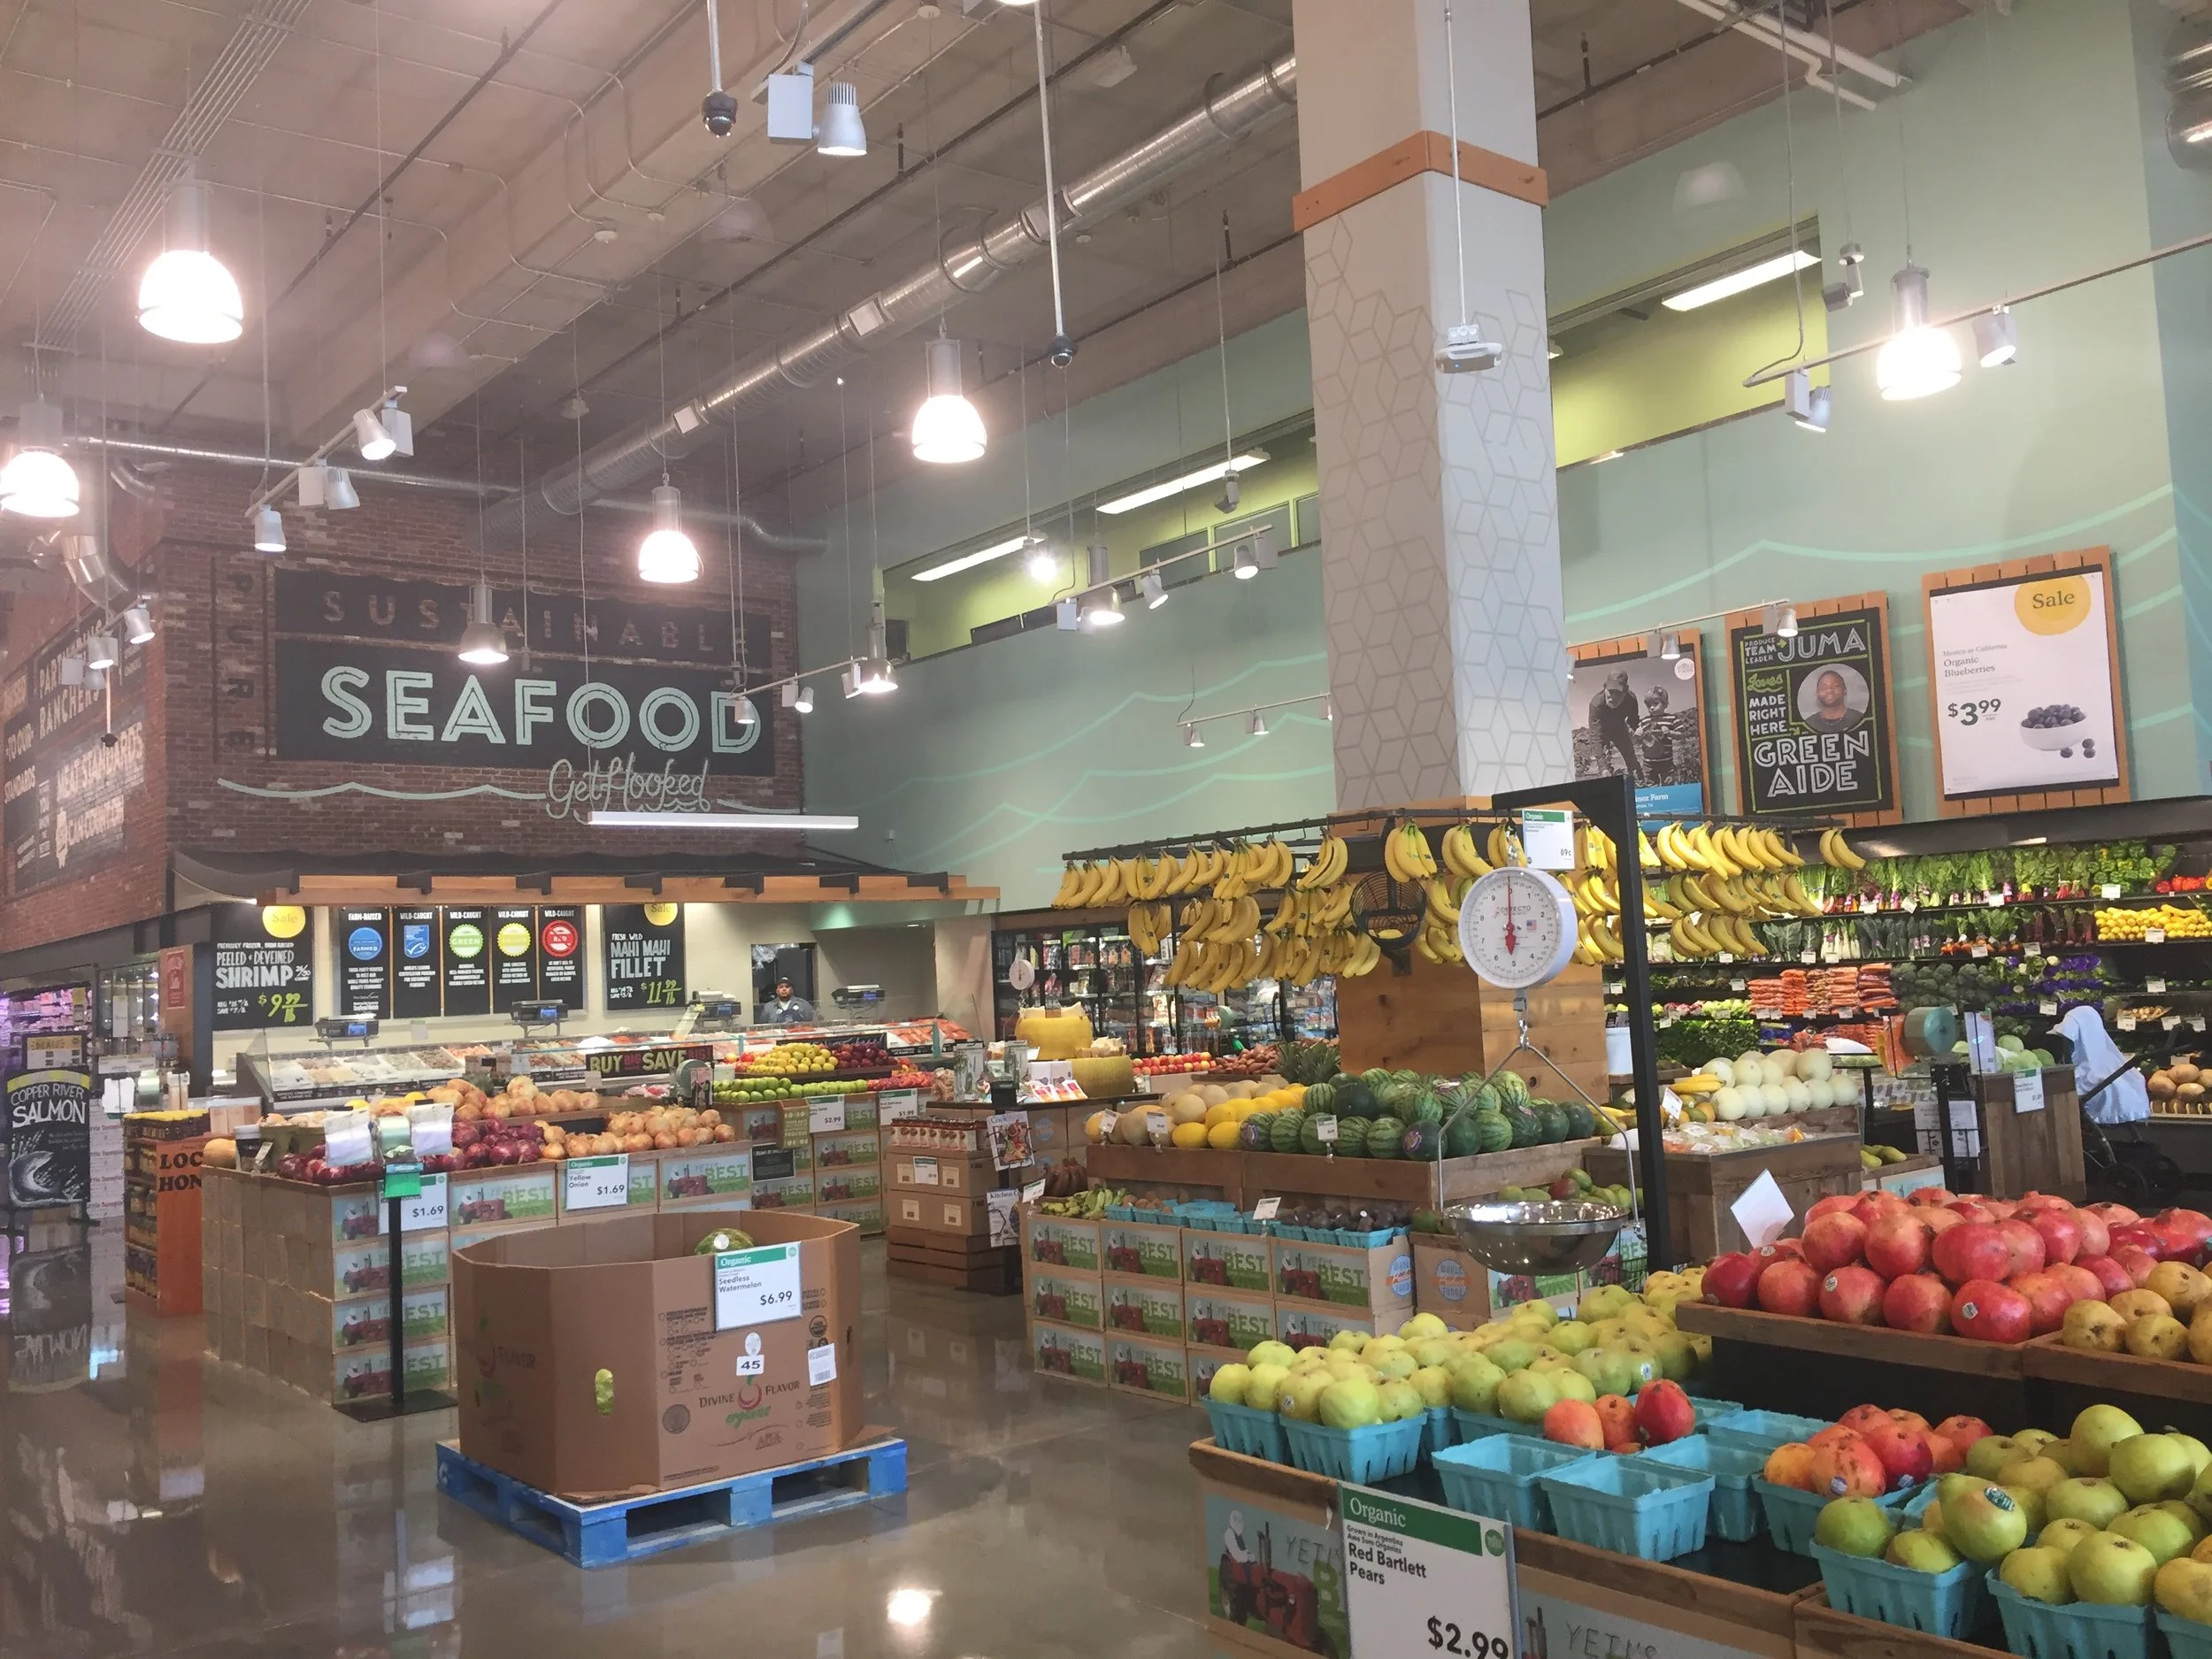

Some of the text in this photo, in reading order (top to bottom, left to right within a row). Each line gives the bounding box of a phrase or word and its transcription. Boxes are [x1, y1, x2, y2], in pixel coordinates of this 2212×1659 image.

[2032, 591, 2075, 609] Sale
[1745, 637, 1776, 647] PRODUCE
[1745, 644, 1777, 657] TEAM
[1778, 627, 1866, 662] JUMA
[1975, 643, 2008, 652] California
[1746, 655, 1773, 664] LEADER
[1944, 656, 1979, 668] Organic
[1944, 664, 1996, 678] Blueberries
[1747, 672, 1784, 693] Loves
[321, 666, 761, 754] SEAFOOD
[1749, 694, 1786, 708] MADE
[1749, 707, 1786, 721] RIGHT
[1750, 720, 1787, 735] HERE
[1754, 730, 1870, 768] GREEN
[545, 752, 711, 819] Get Hooked
[1767, 761, 1858, 797] AIDE
[1525, 812, 1544, 821] Organic
[651, 902, 671, 912] Sale
[272, 913, 297, 923] Sale
[611, 940, 671, 957] MAHI MAHI
[217, 952, 246, 966] PEELED
[254, 950, 294, 964] DEVEINED
[216, 965, 293, 988] SHRIMP
[611, 956, 665, 979] FILLET
[590, 1054, 623, 1073] BUY
[641, 1049, 687, 1071] SAVE
[11, 1082, 84, 1106] COPPER RIVER
[12, 1099, 87, 1129] SALMON
[846, 1108, 874, 1121] BEST
[846, 1142, 875, 1153] BEST
[160, 1151, 204, 1169] LOC
[706, 1164, 746, 1180] BEST
[159, 1176, 202, 1192] HON
[596, 1184, 626, 1196] $1.69
[631, 1175, 652, 1189] ST
[780, 1184, 810, 1195] BEST
[503, 1187, 549, 1204] BEST
[412, 1205, 444, 1217] $1.69
[1063, 1235, 1094, 1254] BEST
[1138, 1241, 1175, 1260] BEST
[402, 1250, 443, 1269] EST
[720, 1255, 752, 1267] Organic
[1224, 1252, 1265, 1273] BEST
[718, 1275, 749, 1285] Seedless
[1318, 1264, 1363, 1286] BEST
[718, 1281, 762, 1293] Watermelon
[760, 1290, 793, 1306] $6.99
[1064, 1289, 1096, 1310] BEST
[404, 1302, 442, 1322] EST
[1141, 1299, 1178, 1320] BEST
[1227, 1314, 1269, 1335] BEST
[404, 1354, 442, 1371] EST
[1069, 1343, 1102, 1364] BEST
[741, 1360, 760, 1369] 45
[1145, 1356, 1181, 1378] BEST
[699, 1380, 800, 1408] DIVINE FLAVOR
[1349, 1497, 1407, 1528] Organic
[1347, 1525, 1367, 1536] Grown
[1374, 1532, 1403, 1547] Argentina
[1348, 1542, 1426, 1578] Red Bartlett
[1350, 1562, 1385, 1585] Pears
[1427, 1616, 1509, 1659] $2.99
